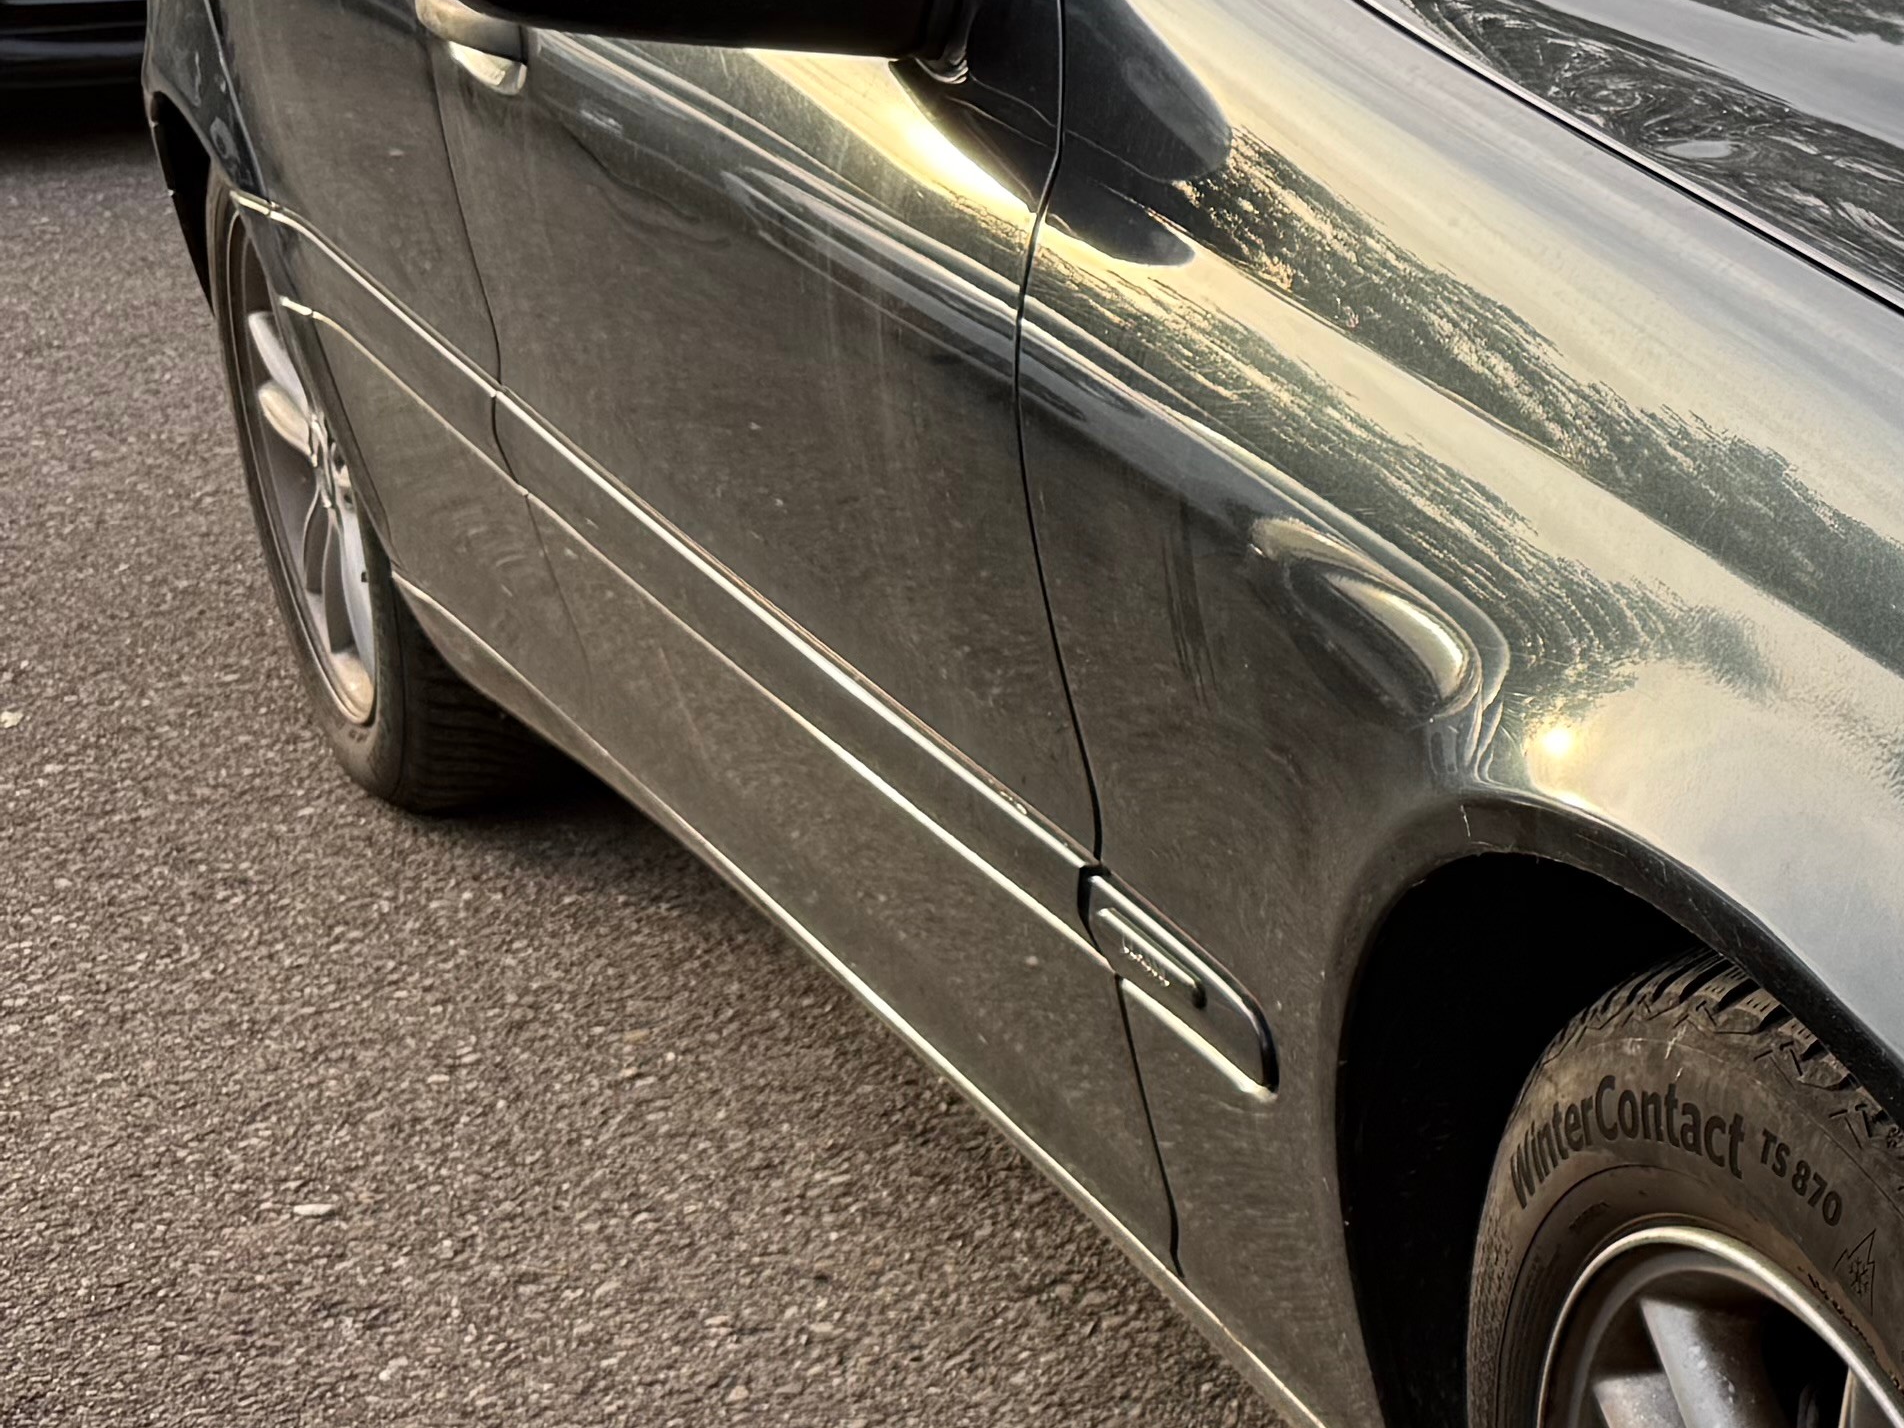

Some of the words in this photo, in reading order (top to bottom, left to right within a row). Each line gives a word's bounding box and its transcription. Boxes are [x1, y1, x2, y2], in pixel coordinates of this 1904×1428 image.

[1510, 1075, 1745, 1209] WinterContact
[1761, 1128, 1790, 1179] TS
[1791, 1162, 1843, 1227] 870
